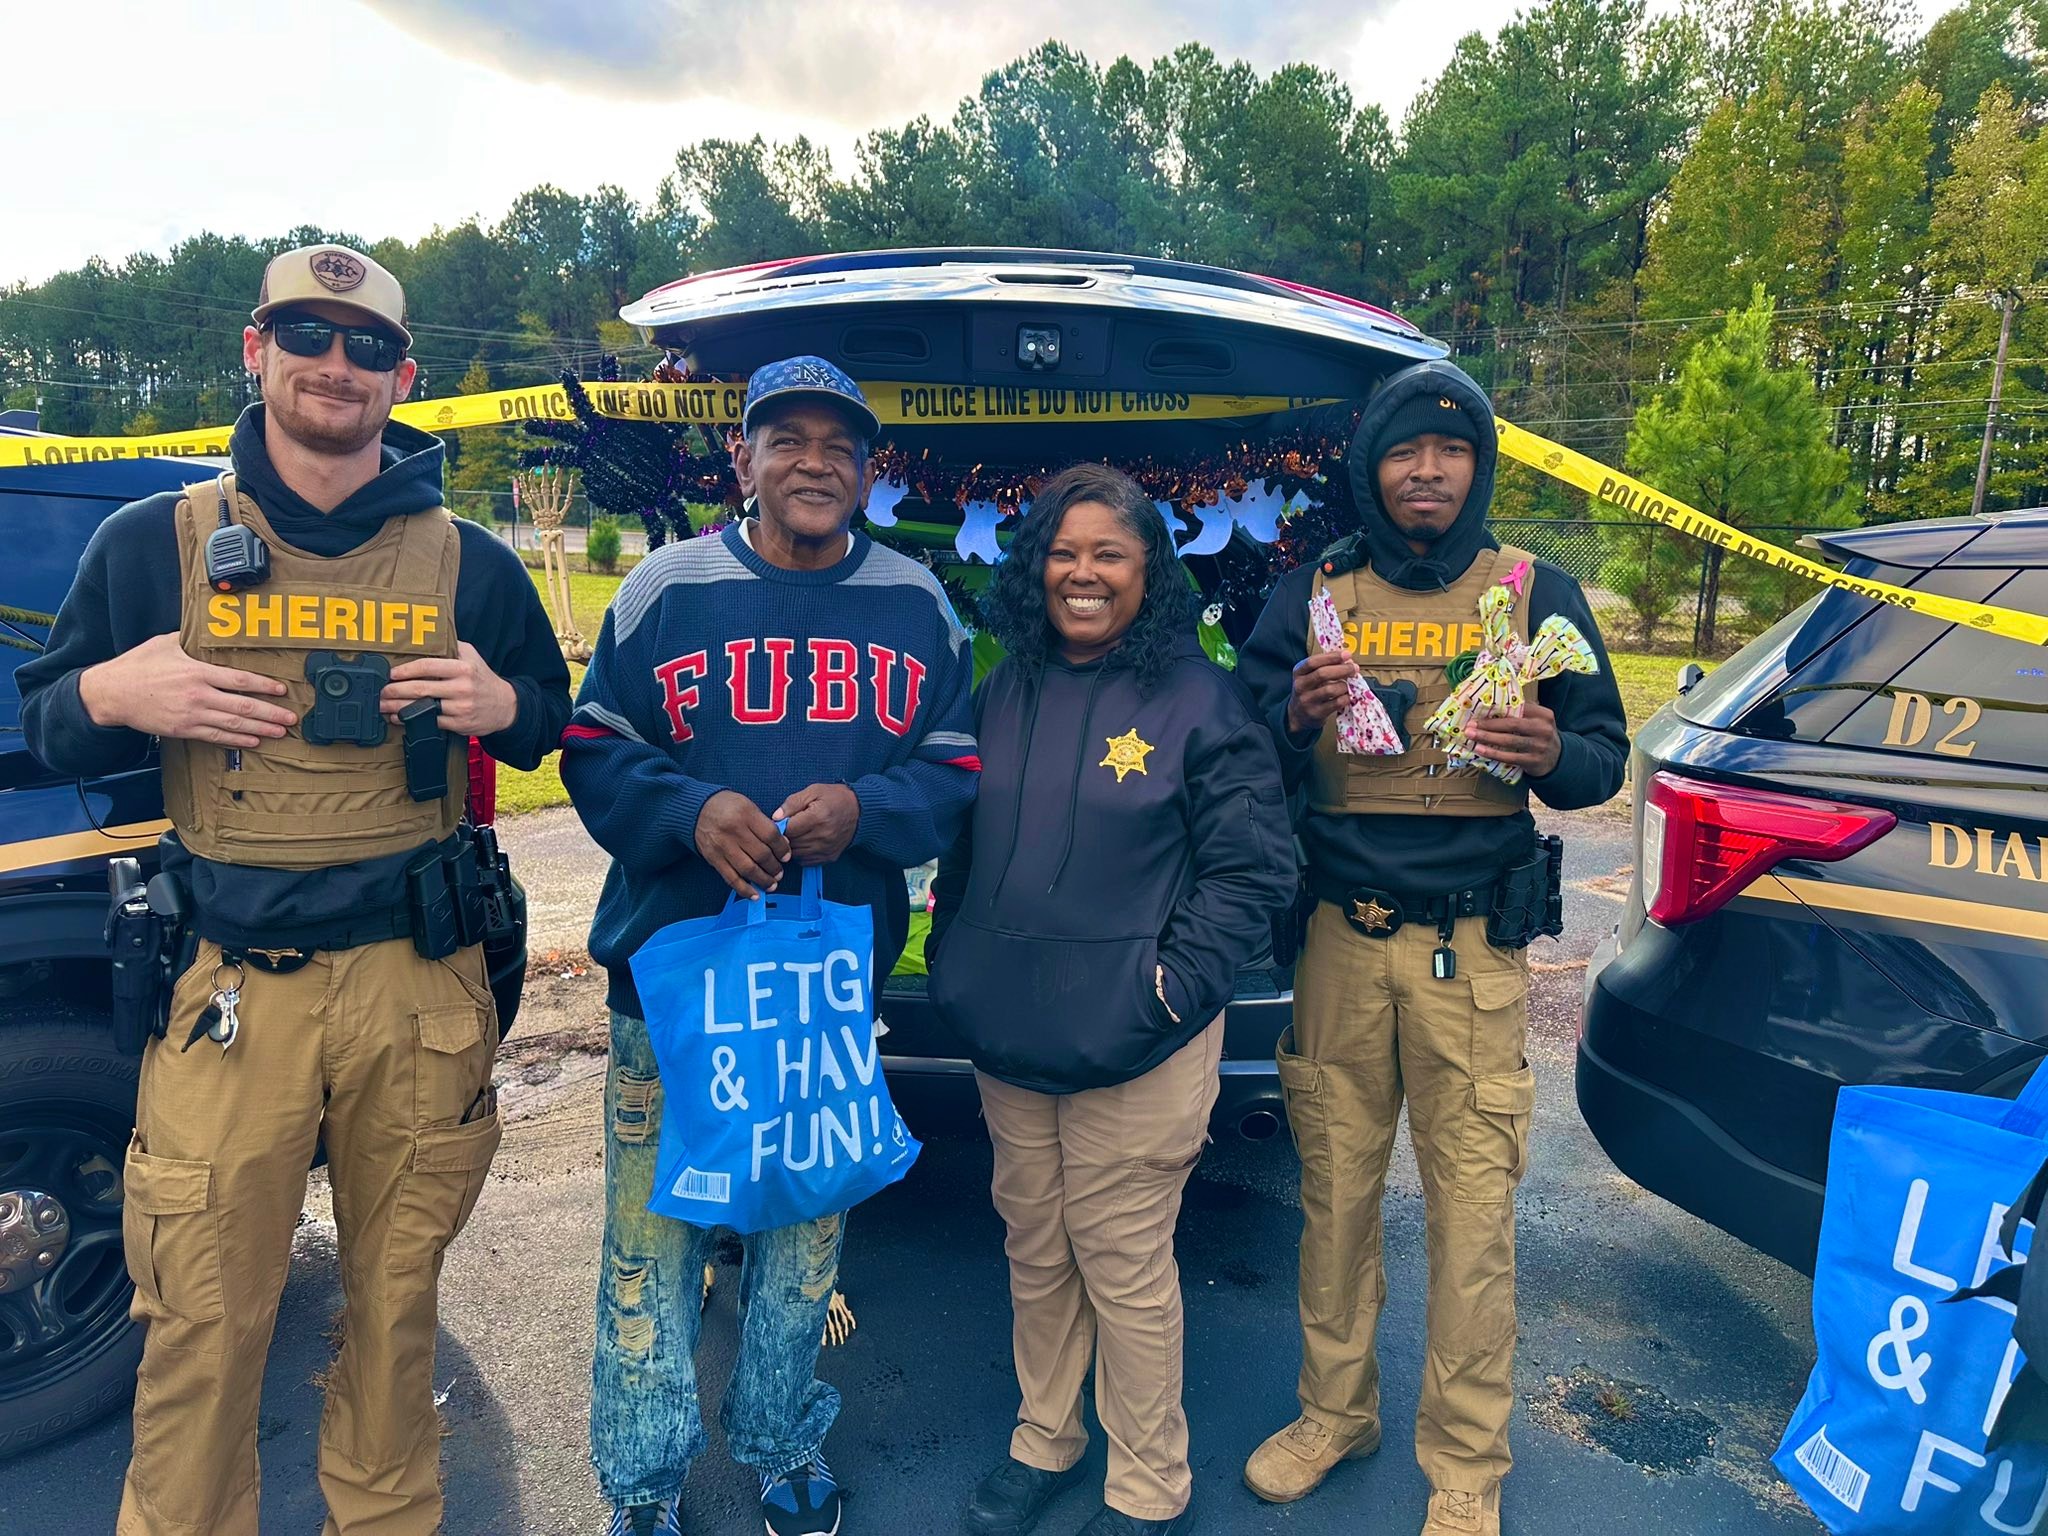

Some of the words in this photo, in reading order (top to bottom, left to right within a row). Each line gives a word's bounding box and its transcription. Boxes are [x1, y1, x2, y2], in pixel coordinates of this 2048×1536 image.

[500, 392, 573, 420] POLIC
[637, 389, 668, 418] DO
[674, 389, 716, 418] NOT
[901, 386, 977, 418] POLICE
[984, 386, 1030, 417] LINE
[1598, 476, 1678, 525] POLICE
[1680, 515, 1733, 547] LINE
[207, 592, 439, 646] SHERIFF
[1342, 620, 1486, 657] SHERIF
[653, 637, 926, 743] FUBU
[1881, 690, 1983, 757] D2
[704, 949, 874, 1034] LETG
[710, 1045, 749, 1112] &
[776, 1024, 877, 1104] HAV
[750, 1095, 883, 1183] FUN!
[1893, 1177, 2035, 1316] LE
[1866, 1294, 1932, 1405] &
[1900, 1429, 2048, 1536] FU
